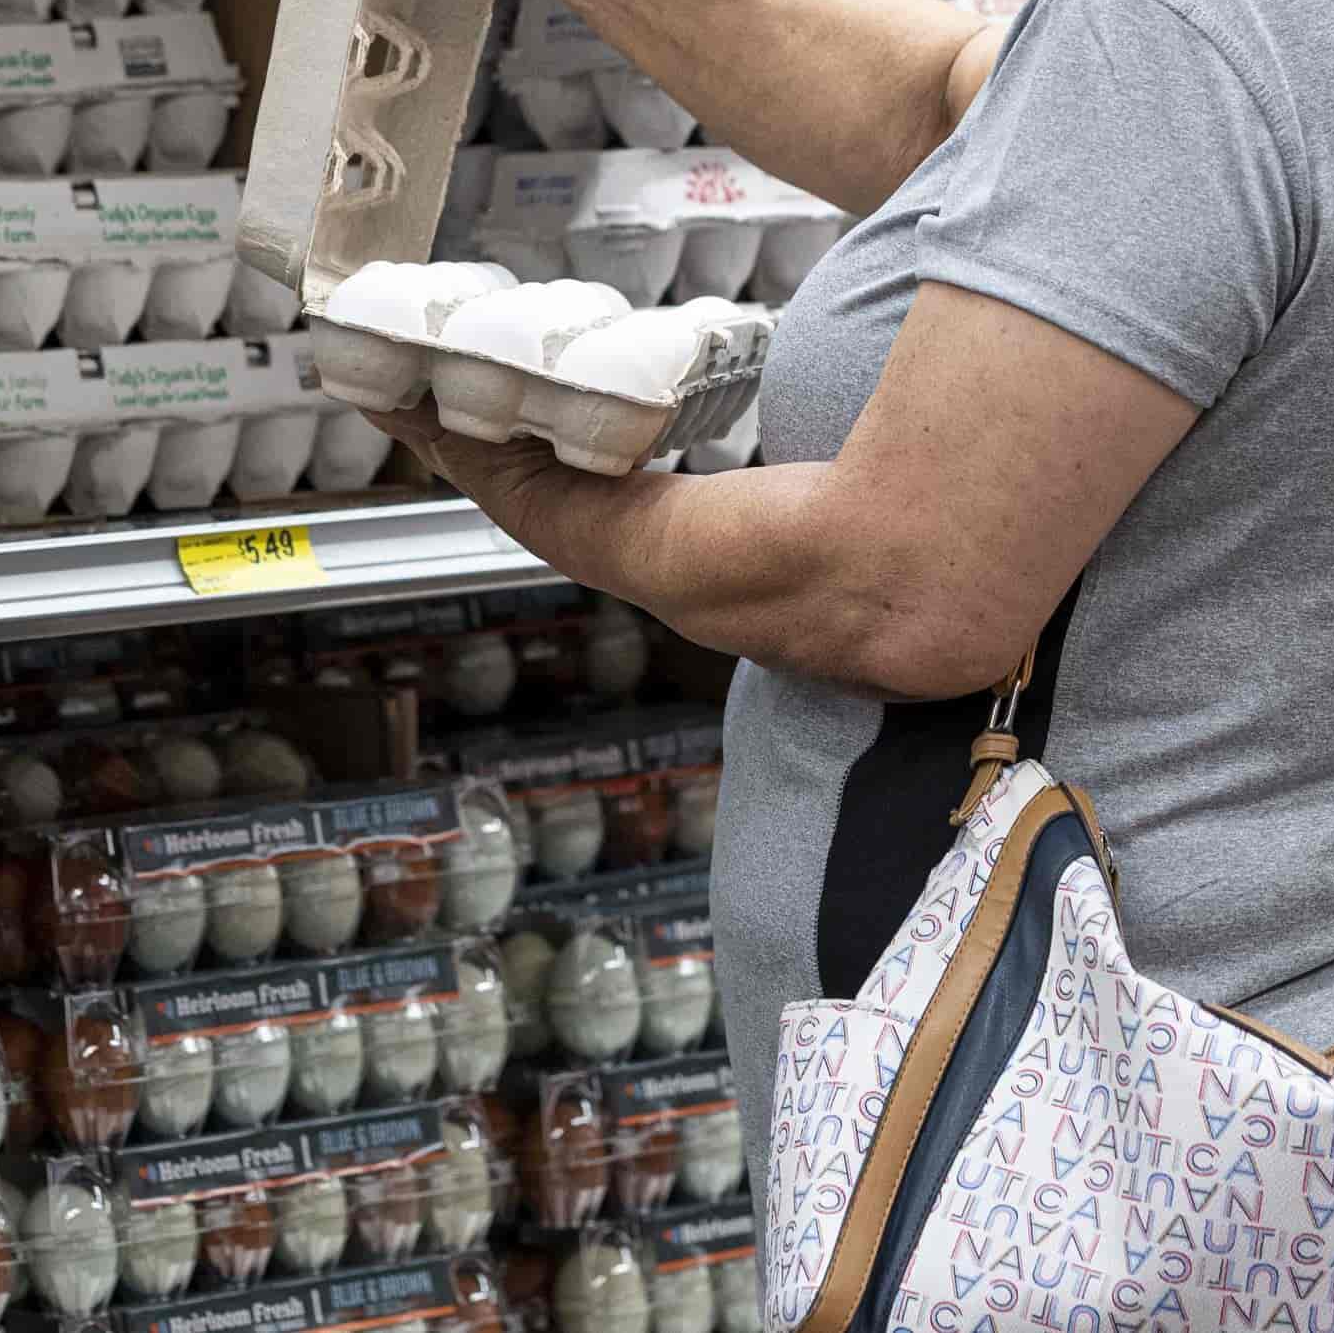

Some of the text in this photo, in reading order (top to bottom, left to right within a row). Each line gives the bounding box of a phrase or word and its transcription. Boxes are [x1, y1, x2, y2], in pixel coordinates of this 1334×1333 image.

[237, 530, 295, 564] $5.49
[165, 828, 251, 857] Heirloom
[252, 817, 306, 845] Fresh
[175, 990, 258, 1018] Heirloom
[259, 978, 311, 1004] Fresh
[1017, 1038, 1160, 1094] AUTICA
[1010, 1069, 1161, 1130] NAUTIC
[158, 1153, 241, 1182] Heirloom
[242, 1141, 295, 1167] Fresh
[1052, 1113, 1263, 1188] NAUTICA
[1052, 1146, 1264, 1224] NAUTICA
[950, 1228, 1188, 1323] NAUTICA
[253, 1295, 306, 1323] Fresh
